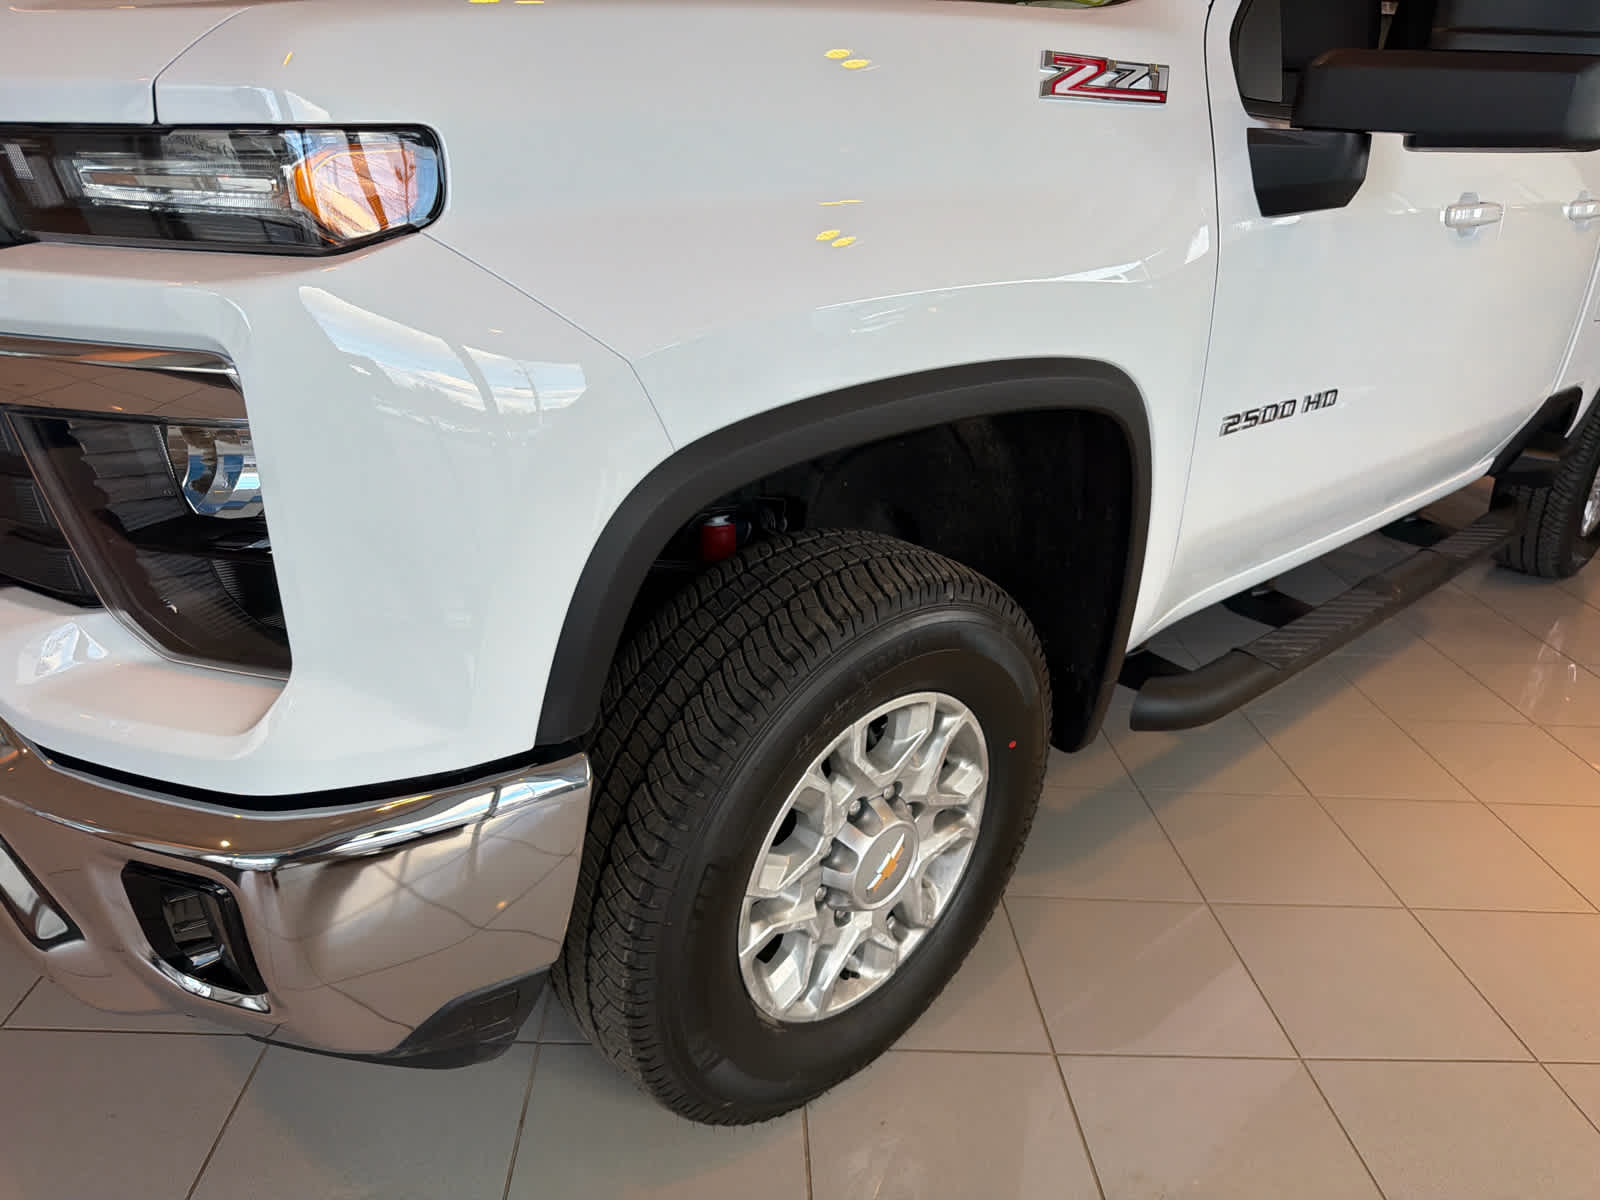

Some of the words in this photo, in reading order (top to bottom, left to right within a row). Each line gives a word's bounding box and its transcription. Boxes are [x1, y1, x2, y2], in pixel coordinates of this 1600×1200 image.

[1040, 50, 1169, 103] Z71
[1219, 399, 1297, 437] 2500
[1301, 388, 1338, 413] HD
